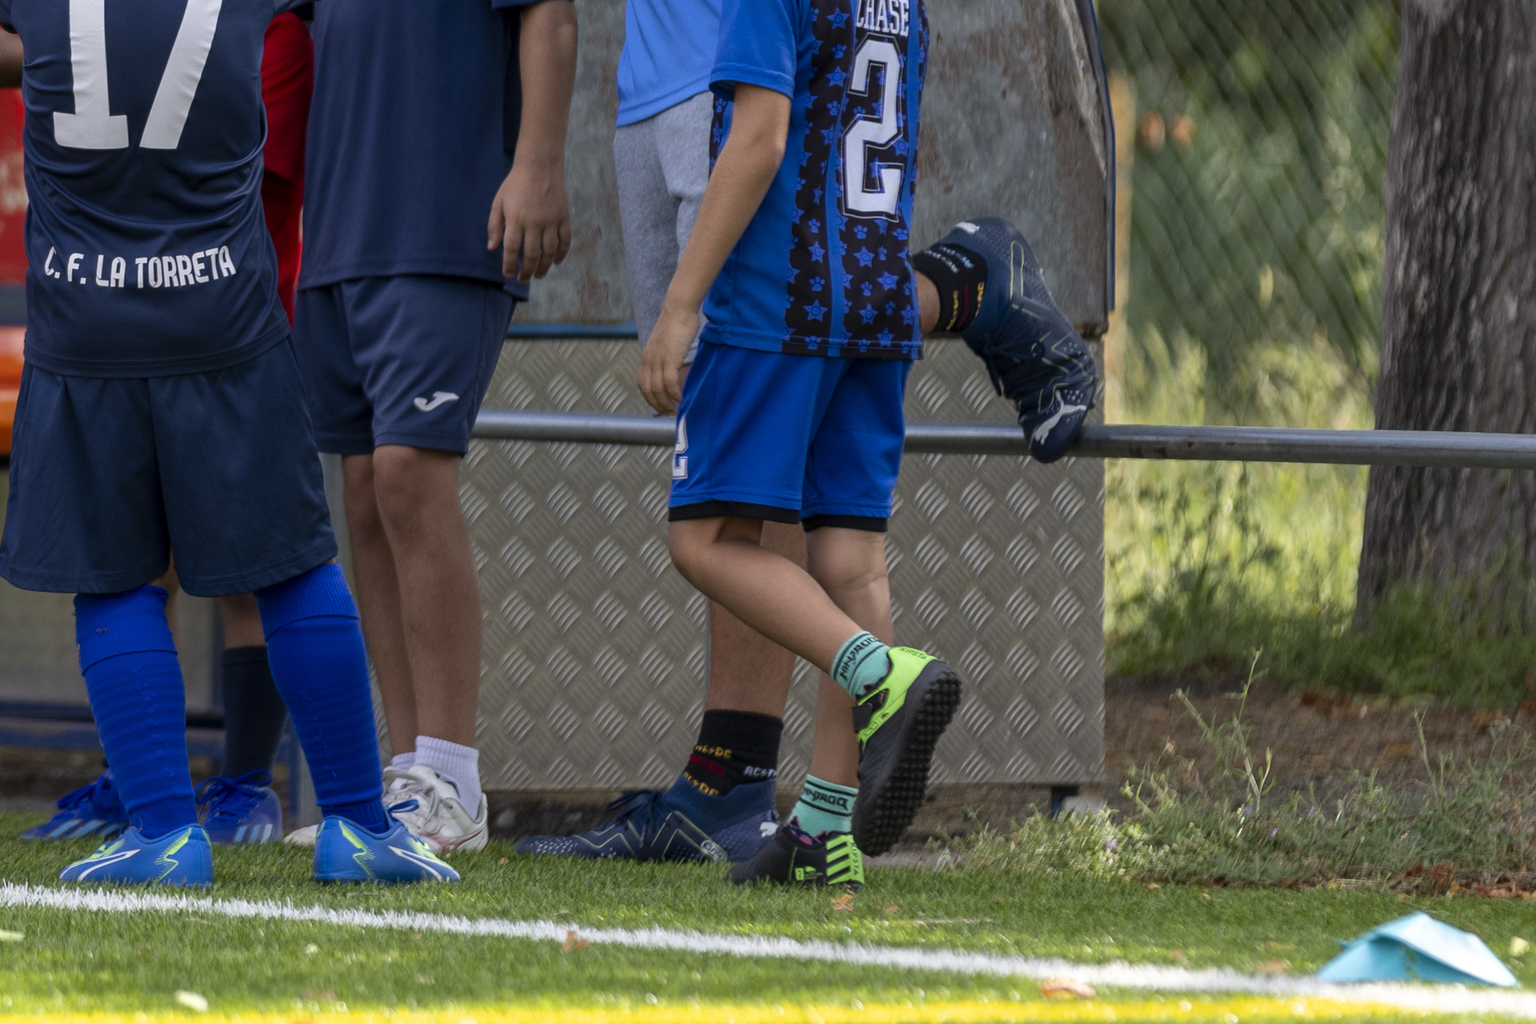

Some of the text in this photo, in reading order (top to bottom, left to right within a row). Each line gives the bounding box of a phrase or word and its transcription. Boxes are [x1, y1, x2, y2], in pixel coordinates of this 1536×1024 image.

[839, 31, 905, 223] 2
[67, 252, 87, 285] F.
[95, 254, 126, 288] LA
[135, 244, 237, 289] TORRETA
[899, 646, 928, 661] KIPSTA
